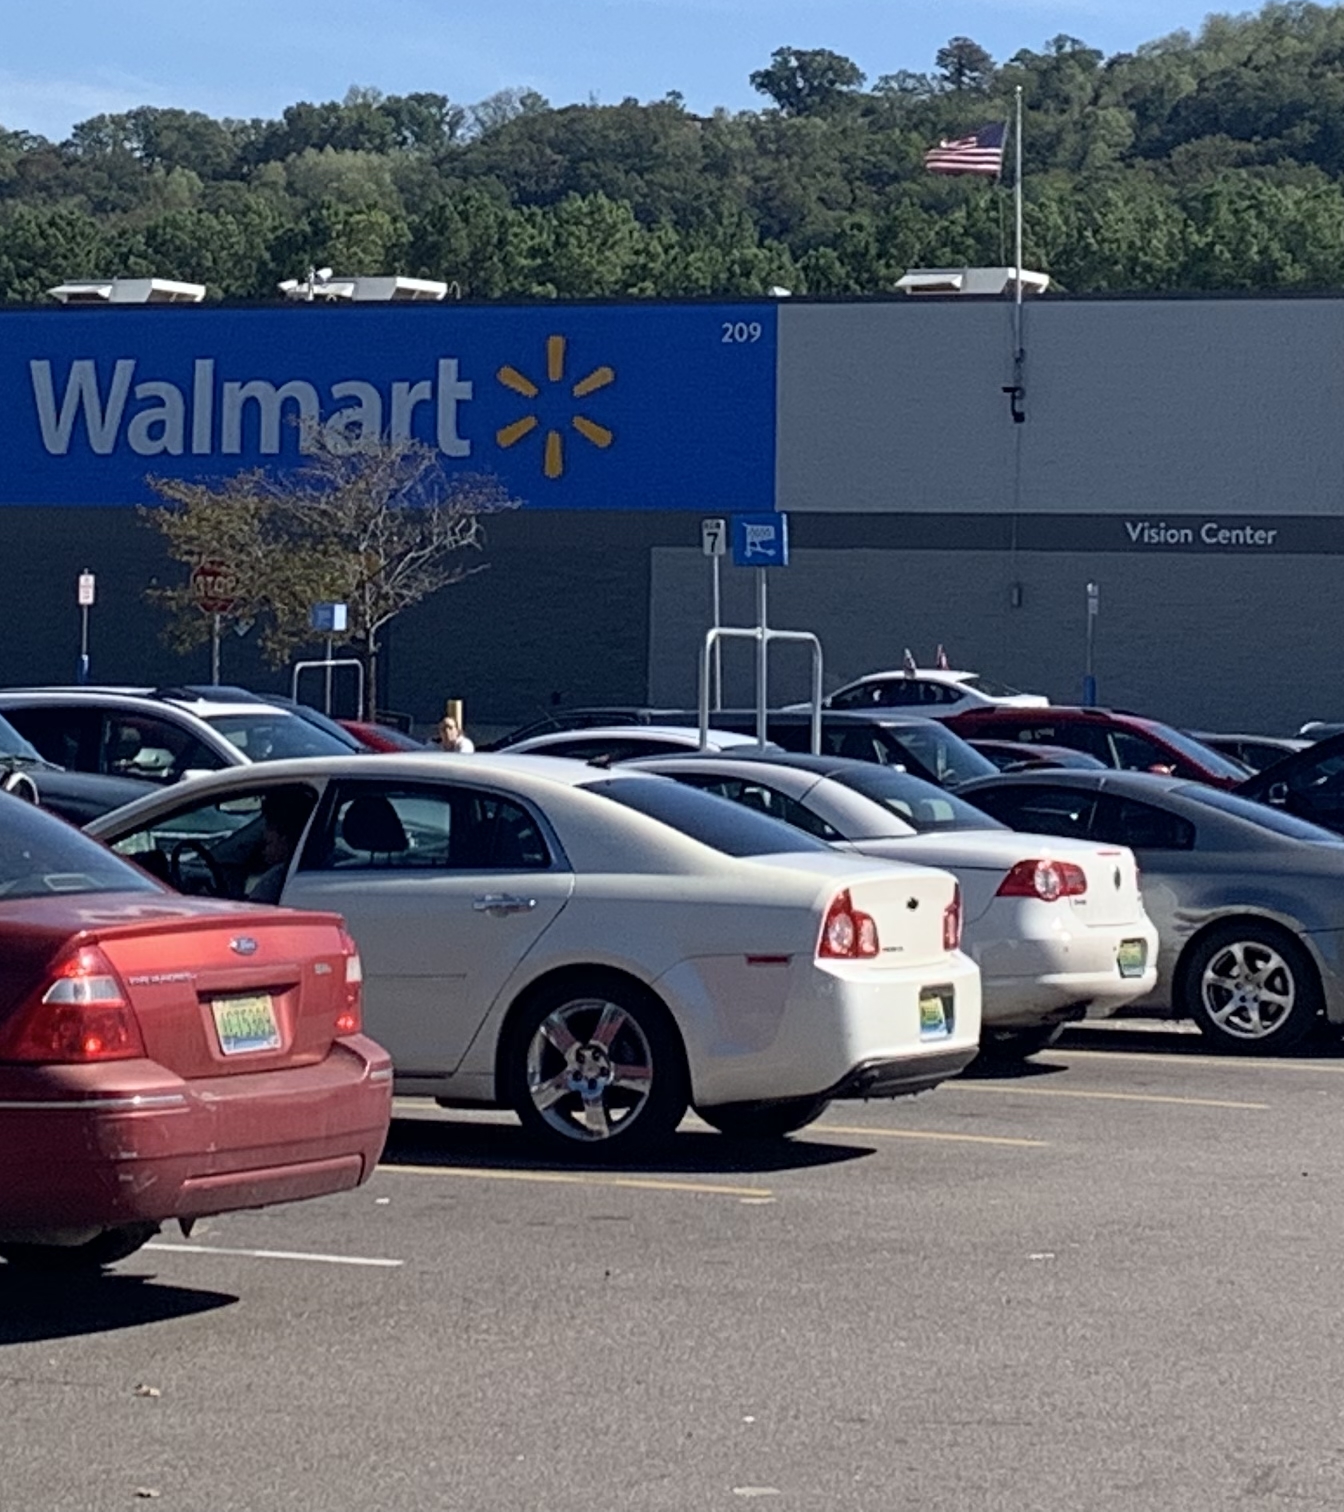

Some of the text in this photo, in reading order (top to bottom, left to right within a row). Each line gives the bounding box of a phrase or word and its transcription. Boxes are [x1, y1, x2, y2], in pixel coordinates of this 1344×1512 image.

[721, 322, 762, 343] 209
[29, 358, 473, 457] Walmart
[706, 532, 719, 553] 7
[1125, 522, 1278, 545] Vision Center
